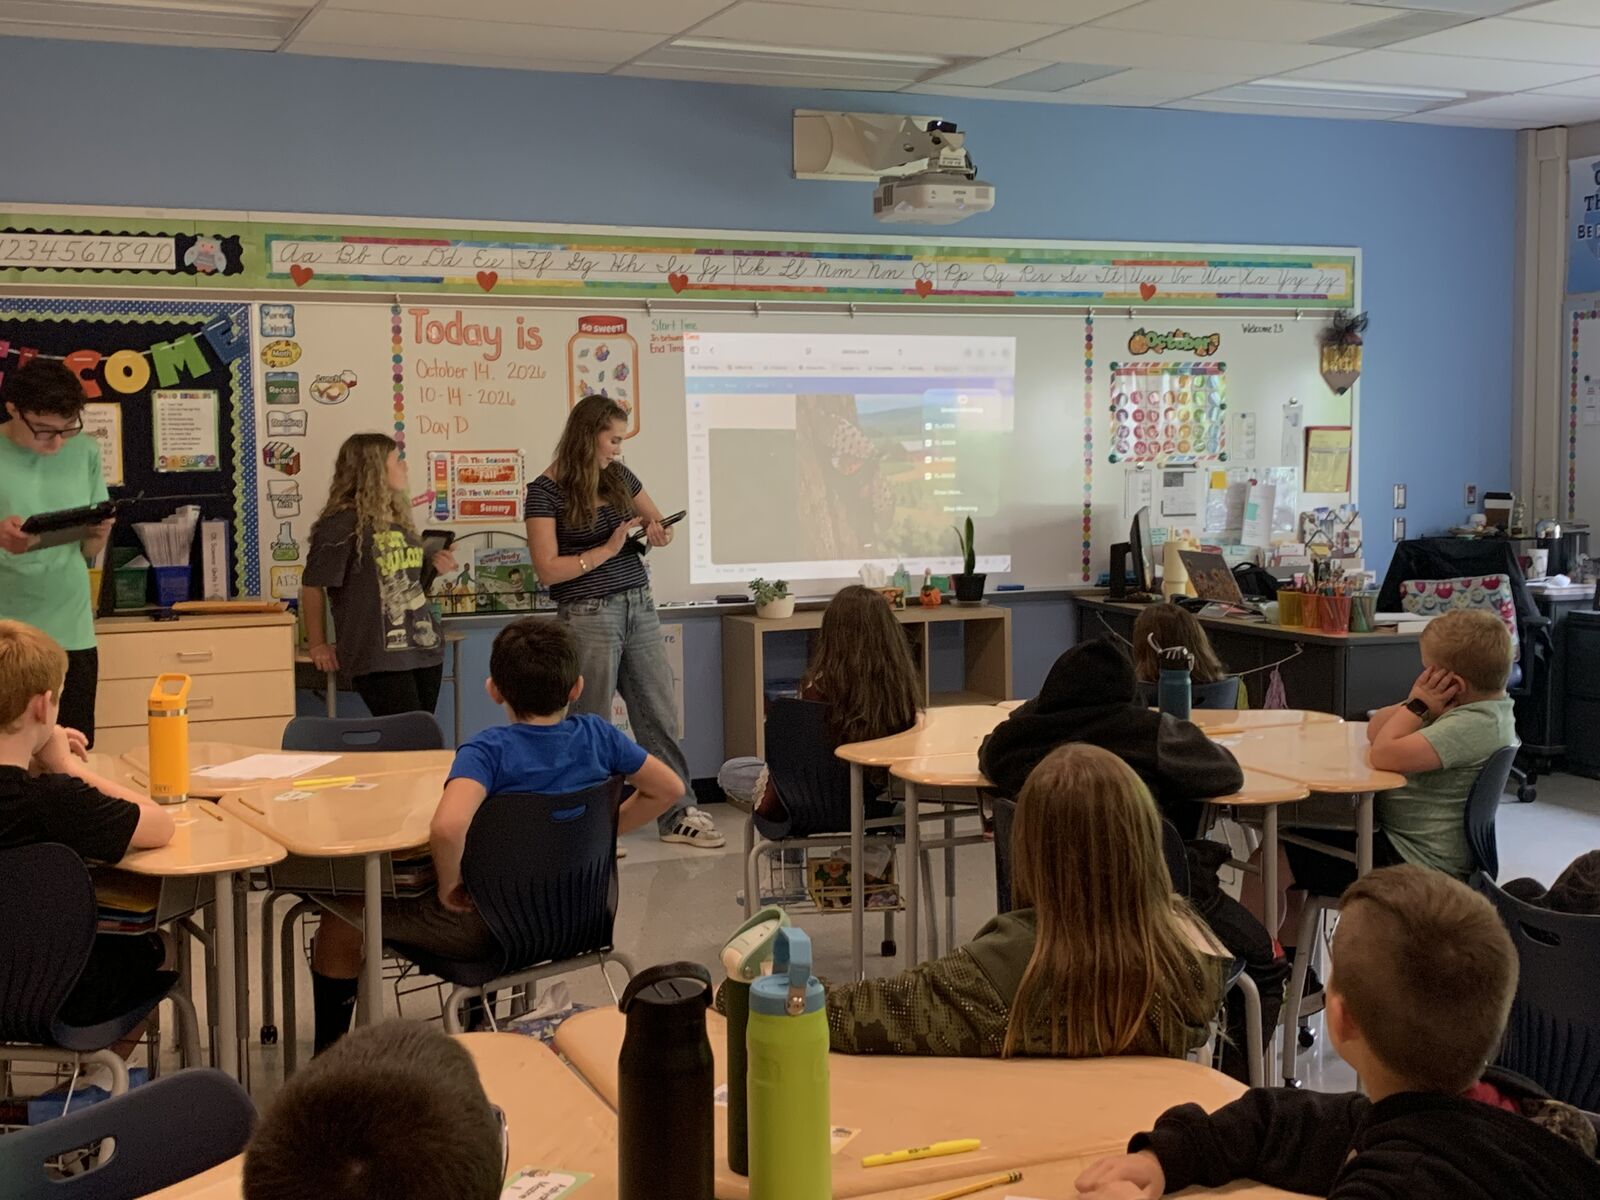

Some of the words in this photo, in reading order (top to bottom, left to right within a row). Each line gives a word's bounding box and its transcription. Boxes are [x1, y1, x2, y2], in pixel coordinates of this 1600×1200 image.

[651, 319, 676, 331] Start
[1241, 323, 1272, 333] Welcome
[408, 308, 502, 361] Today
[517, 316, 543, 350] is
[1145, 331, 1211, 350] October
[650, 343, 665, 353] End
[272, 349, 292, 358] Math
[416, 358, 468, 379] October
[507, 361, 547, 380] 2026
[316, 374, 343, 383] Lunch
[268, 386, 296, 394] Recess
[271, 418, 303, 428] Reading
[416, 415, 449, 440] Day
[455, 416, 470, 433] D
[266, 456, 294, 466] Library
[479, 470, 497, 480] Fall
[480, 503, 511, 514] Sunny
